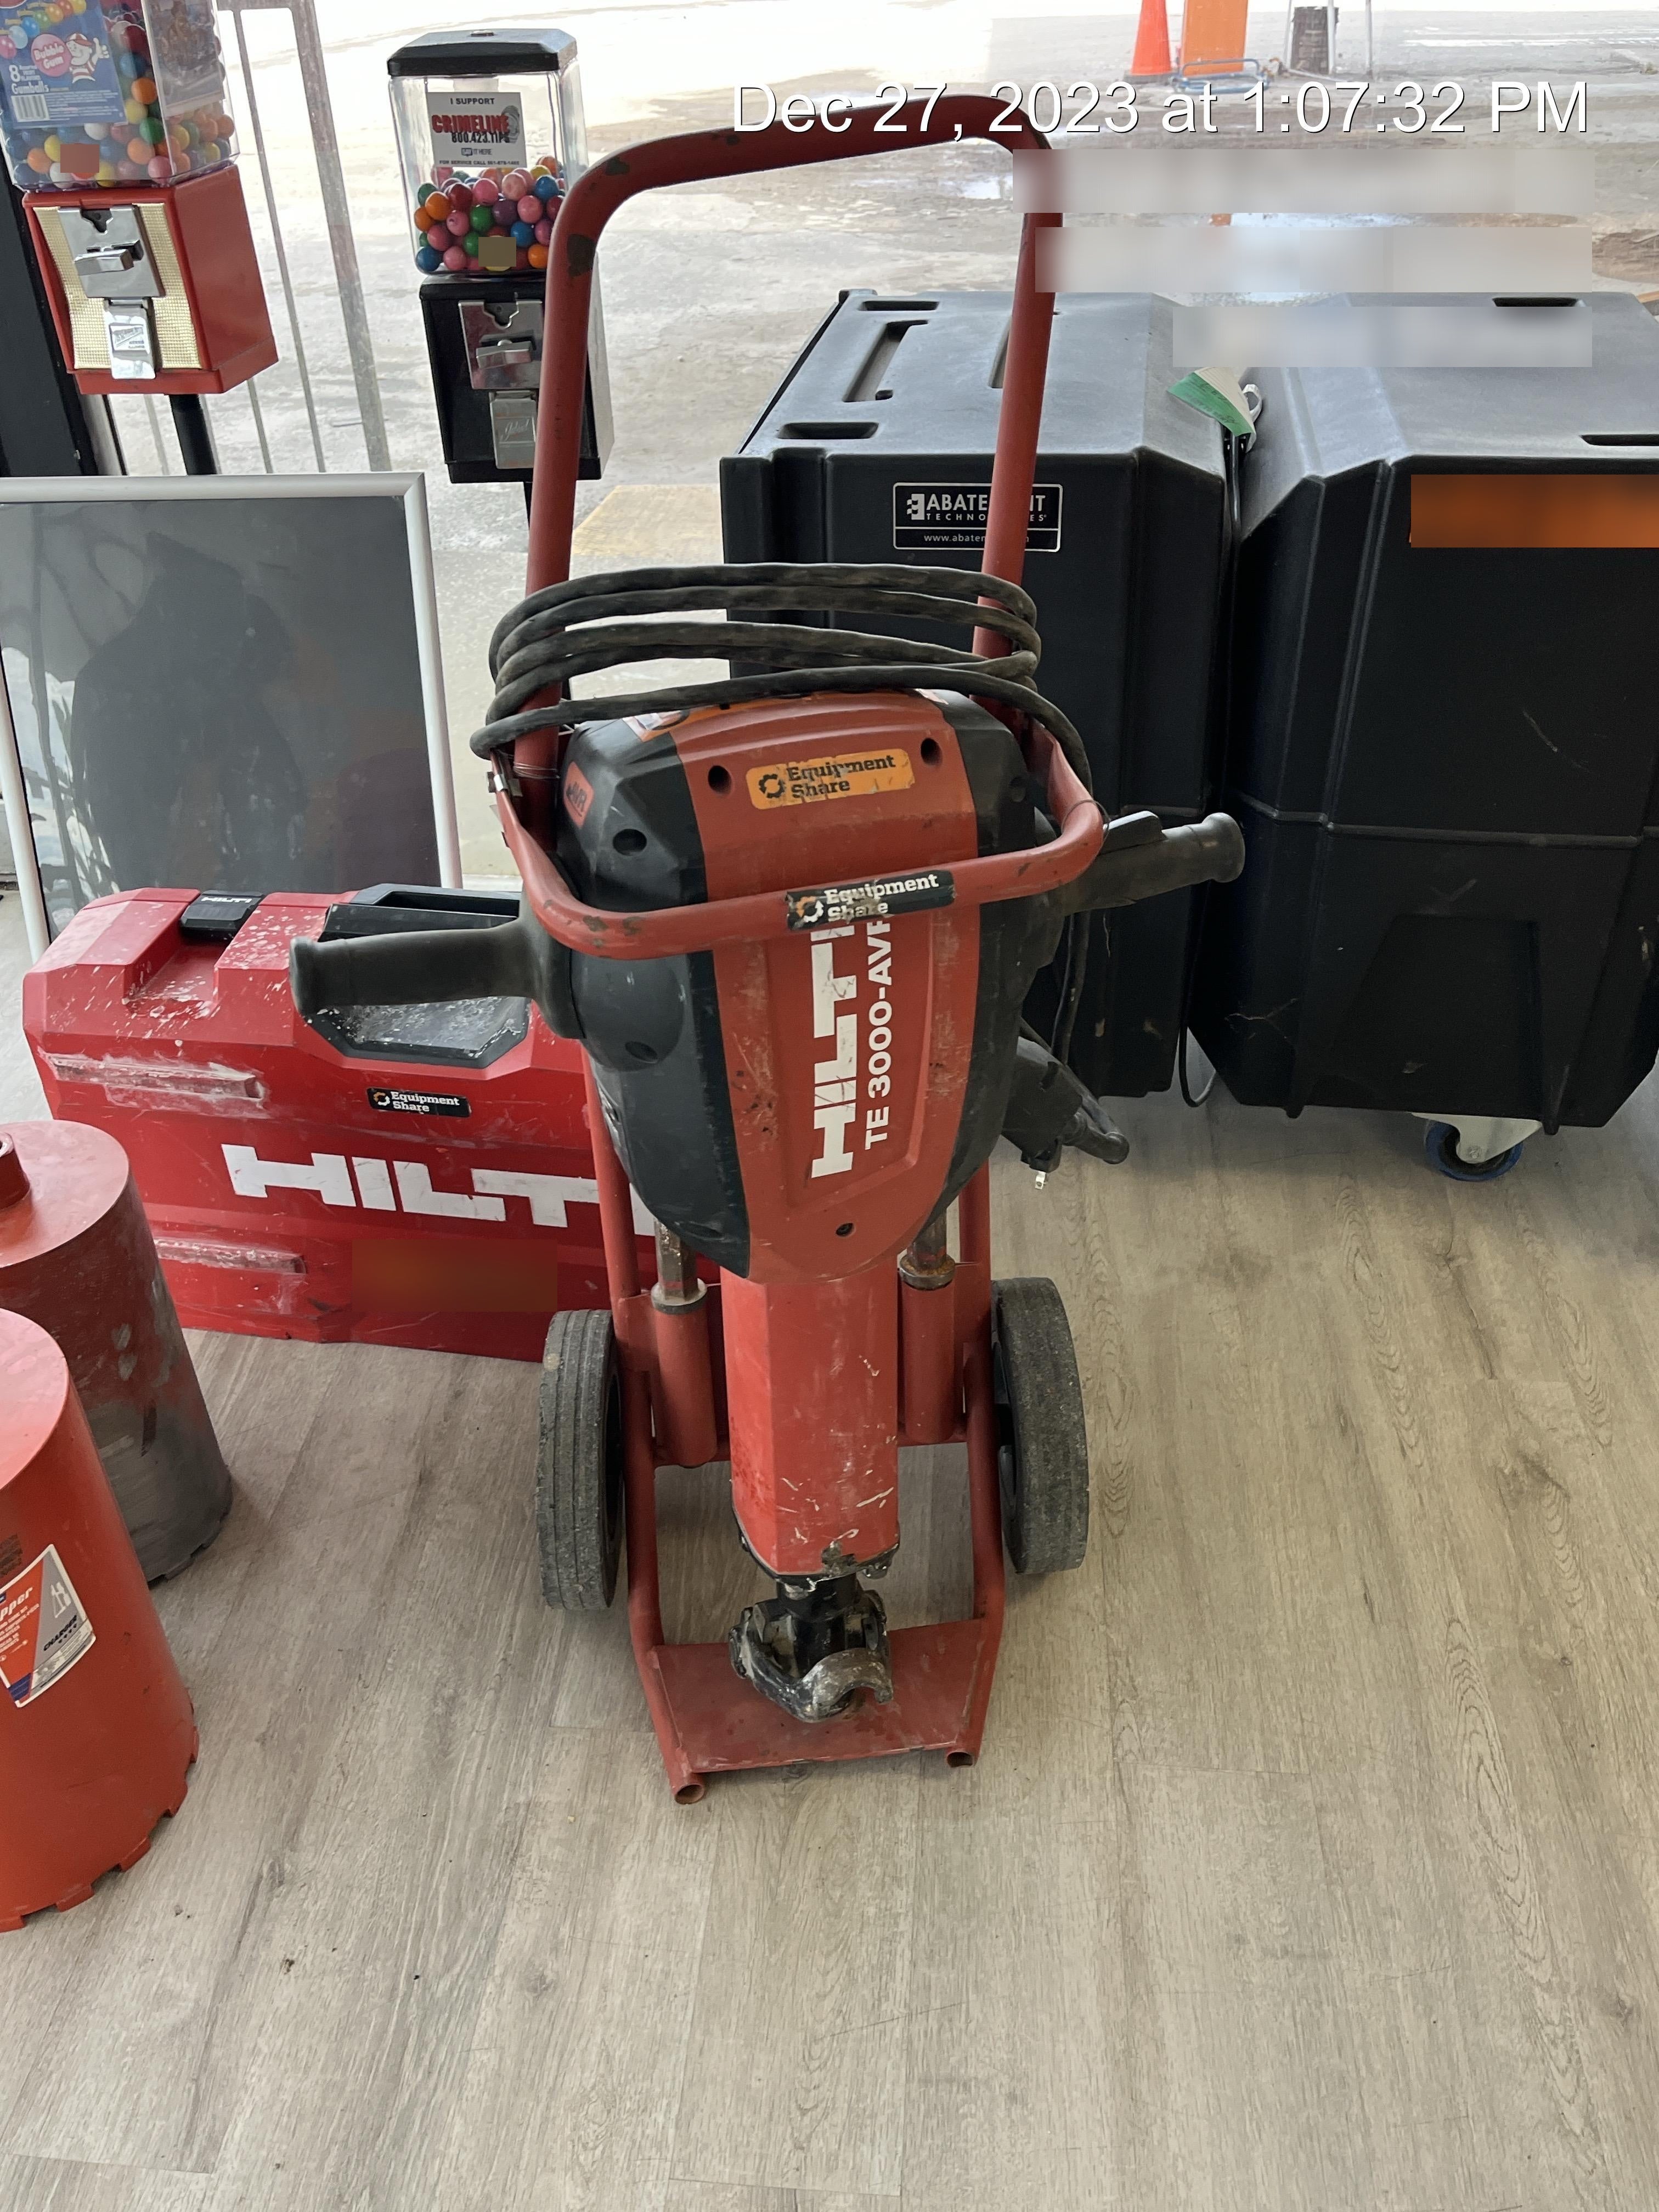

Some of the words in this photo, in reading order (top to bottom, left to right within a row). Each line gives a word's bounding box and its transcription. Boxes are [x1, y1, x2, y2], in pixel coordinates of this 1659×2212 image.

[34, 43, 65, 61] Bubble
[43, 57, 64, 69] Gum
[9, 65, 21, 82] 8
[12, 81, 49, 94] Gumballs
[431, 115, 510, 133] CRIMELINE
[927, 494, 1046, 511] ABATET
[927, 514, 1044, 522] TECHNOES
[924, 534, 1029, 543] www.abate
[787, 755, 895, 782] Equipment
[791, 780, 850, 798] Share
[824, 874, 939, 905] Equipment
[827, 902, 888, 922] Share
[391, 1091, 460, 1105] Equipment
[393, 1101, 430, 1112] Share
[865, 1106, 889, 1150] TE
